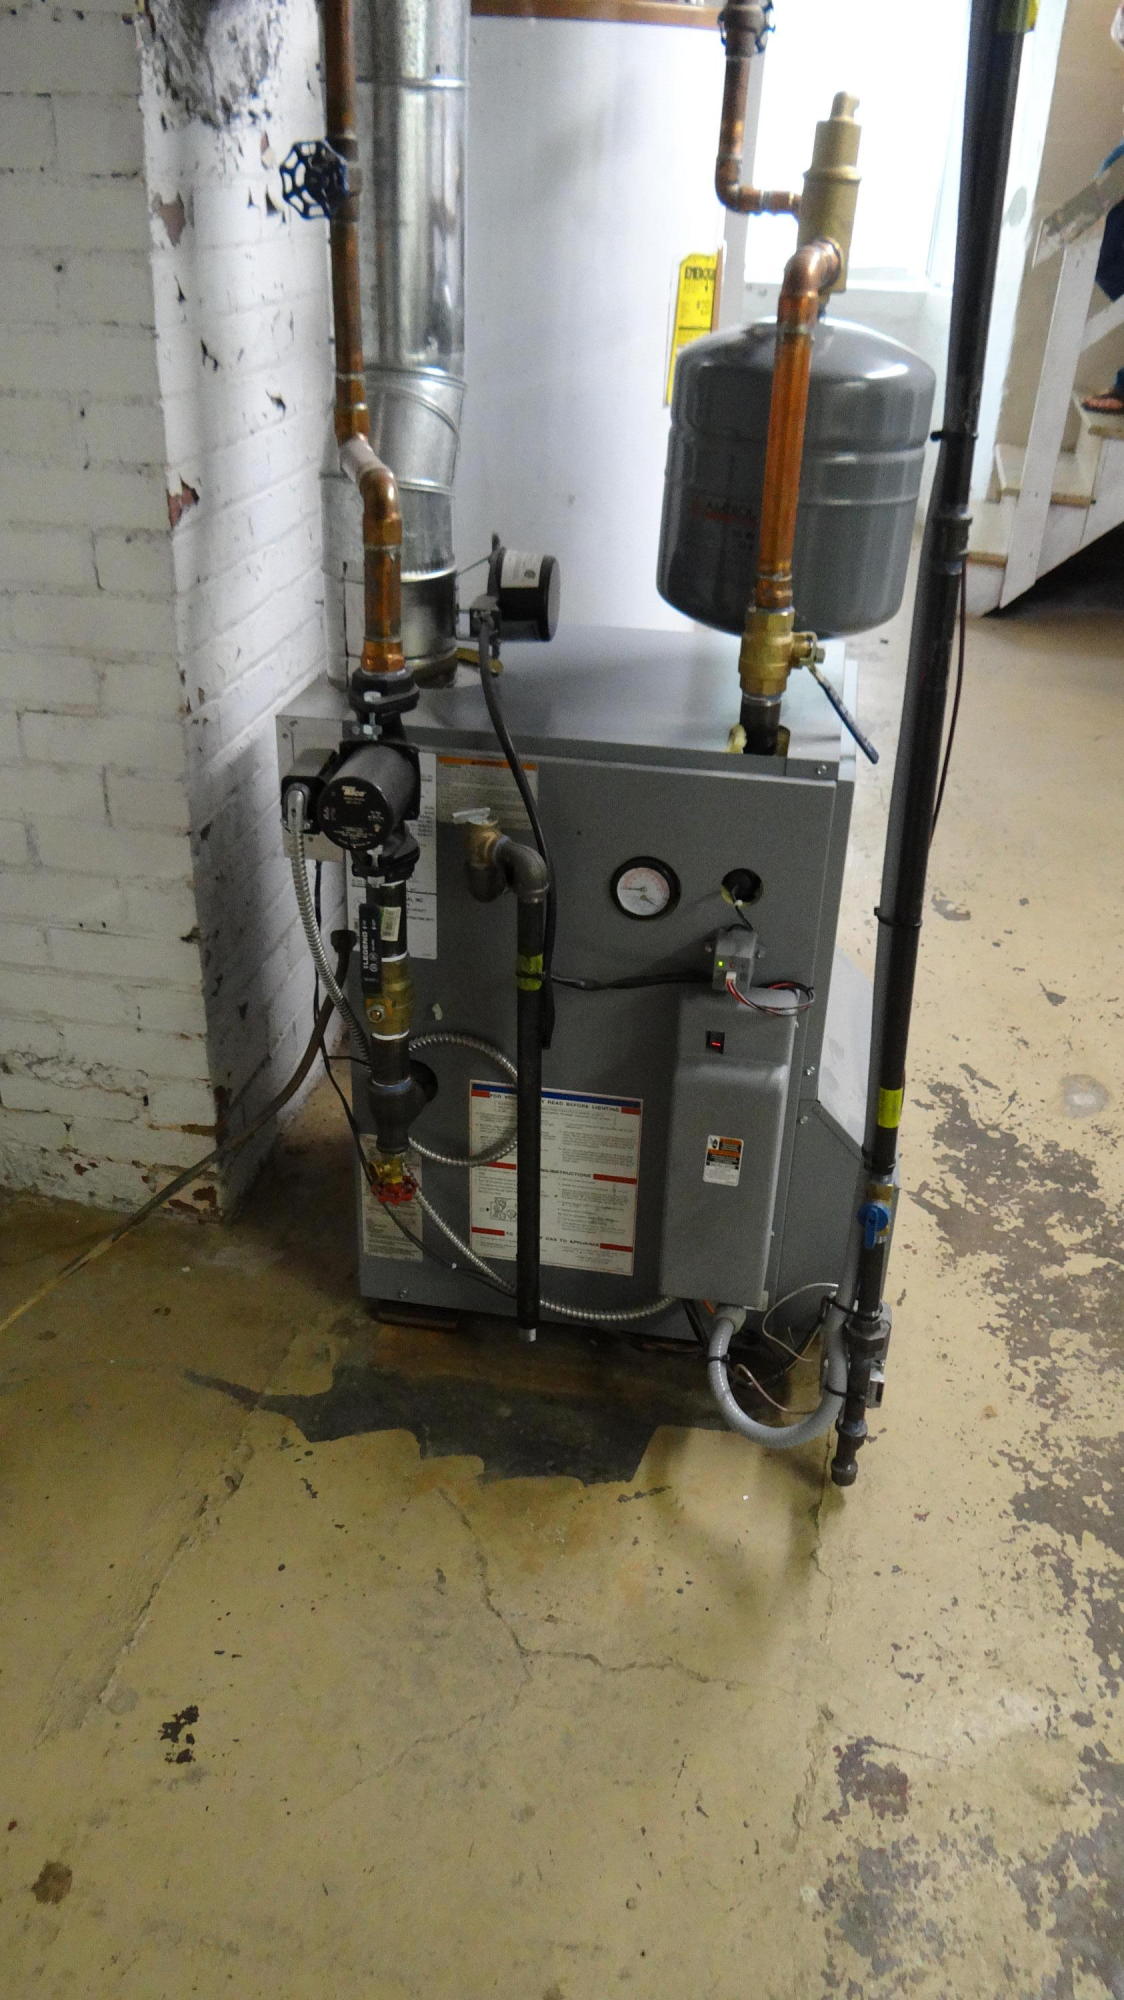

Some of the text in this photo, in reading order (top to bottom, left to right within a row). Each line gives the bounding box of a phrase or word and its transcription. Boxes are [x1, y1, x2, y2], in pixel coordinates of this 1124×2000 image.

[361, 931, 369, 966] LEGEND
[566, 1101, 589, 1109] BEFORE
[591, 1104, 620, 1113] LIGHTING
